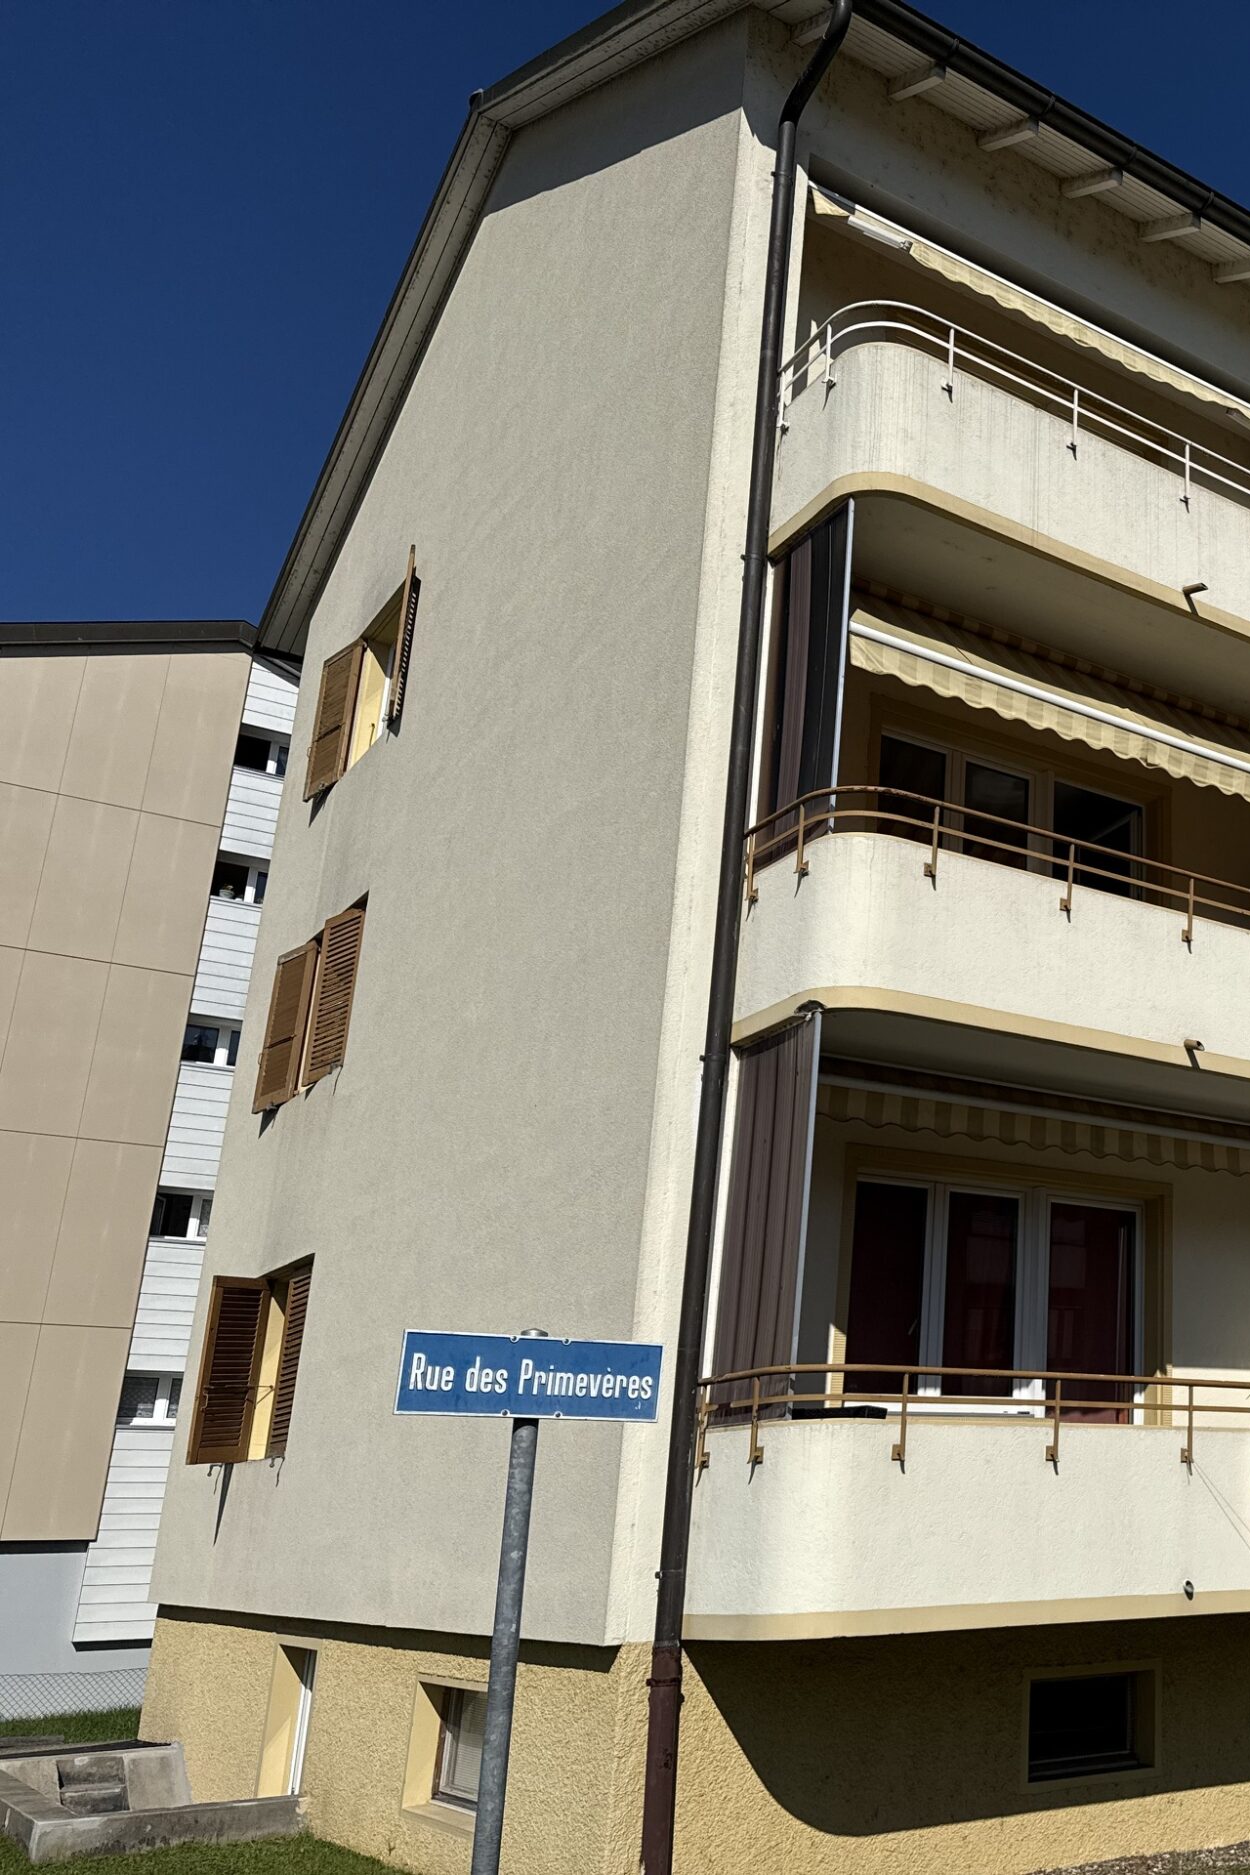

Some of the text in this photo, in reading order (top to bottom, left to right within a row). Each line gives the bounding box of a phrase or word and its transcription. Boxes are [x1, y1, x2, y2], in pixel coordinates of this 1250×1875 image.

[409, 1352, 653, 1400] Rue des Primevères
